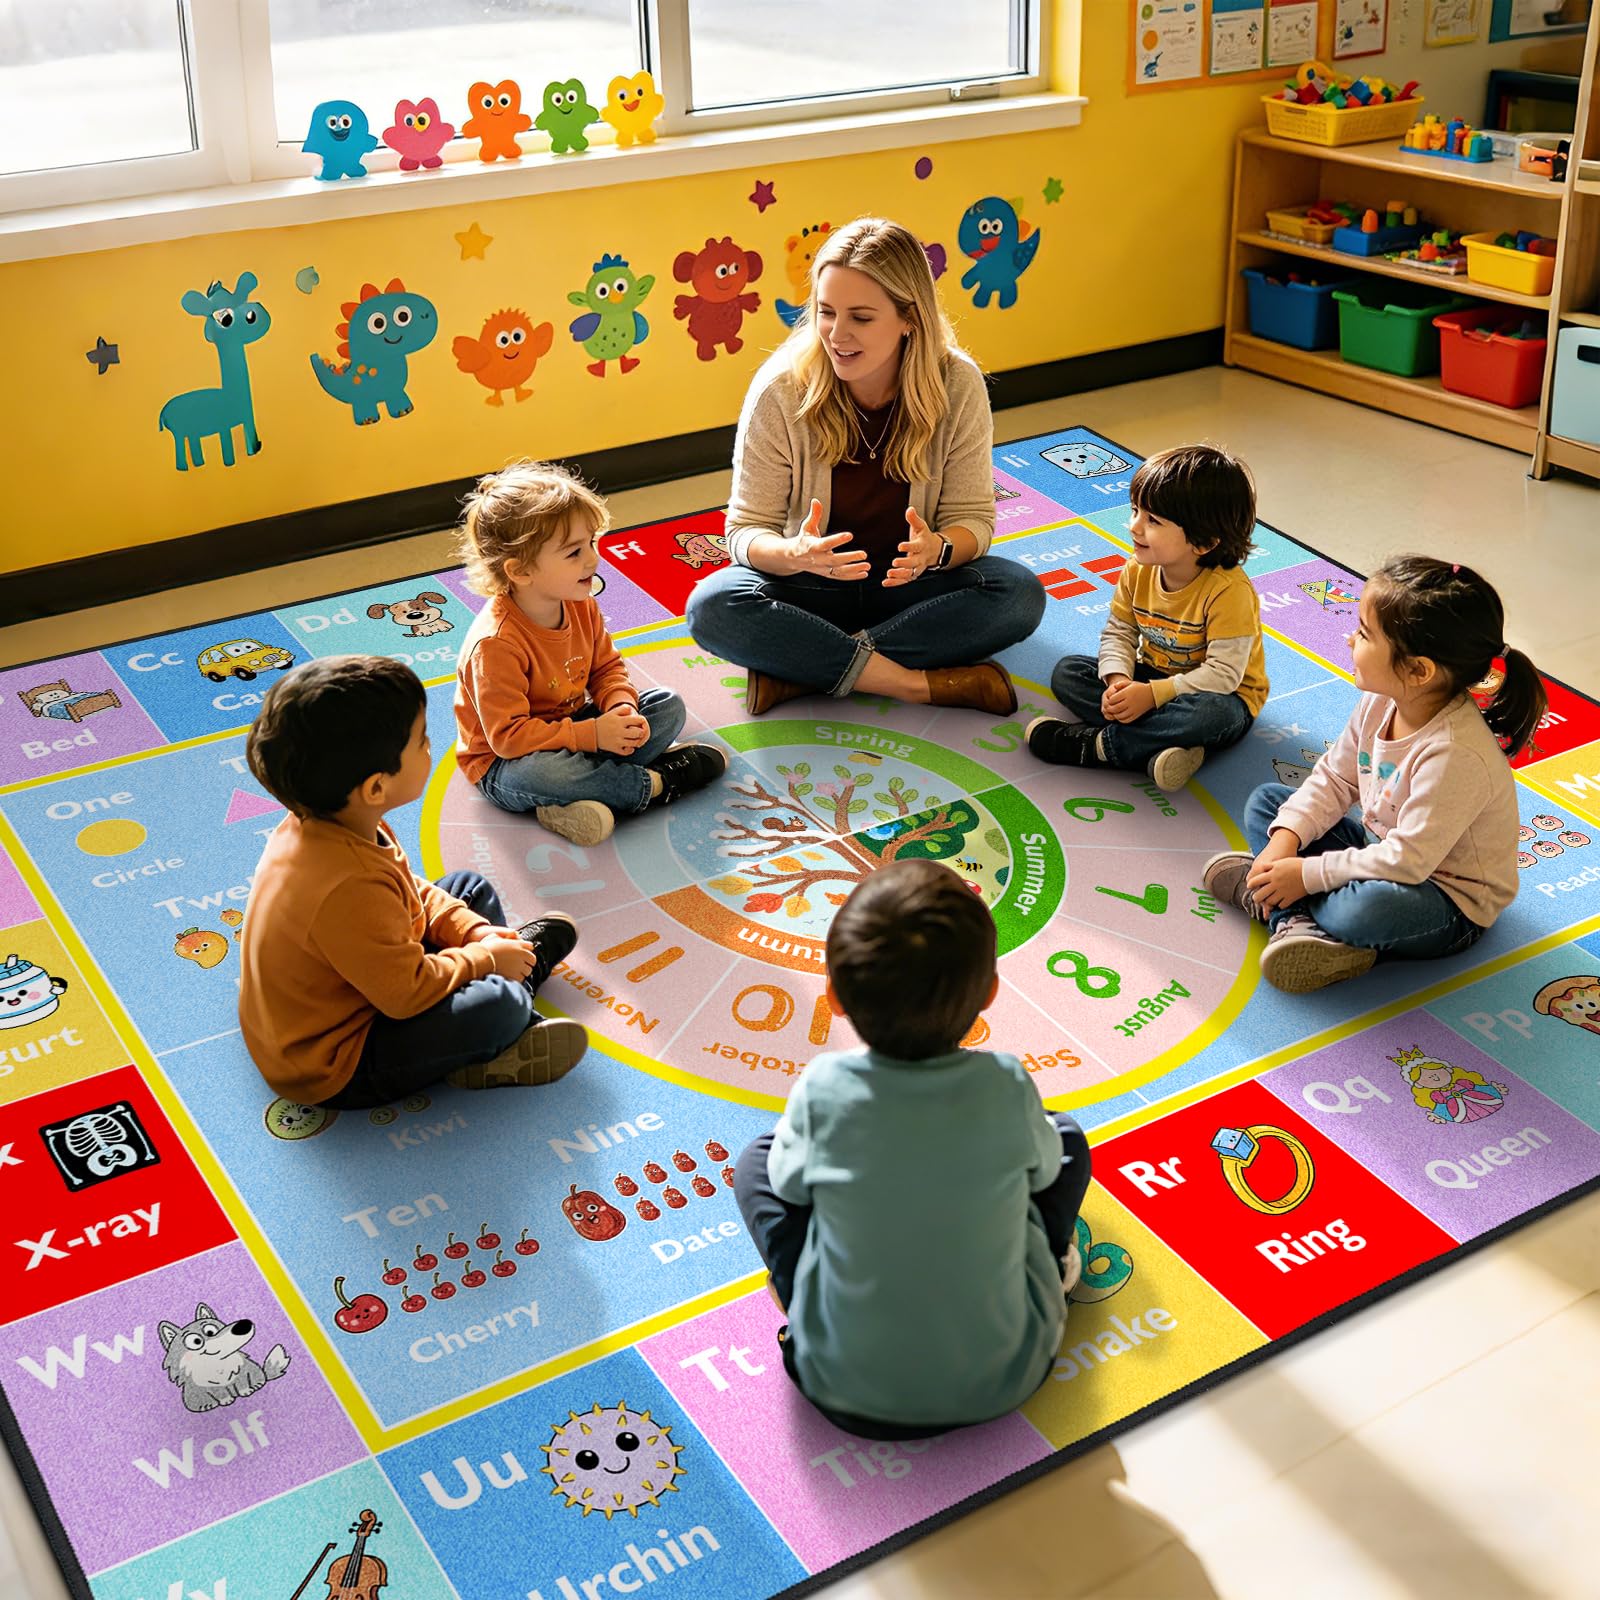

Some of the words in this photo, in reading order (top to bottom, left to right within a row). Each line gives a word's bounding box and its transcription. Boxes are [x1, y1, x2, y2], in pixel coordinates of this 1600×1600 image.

[1091, 478, 1130, 495] Ice
[996, 504, 1035, 521] use
[606, 540, 647, 561] Ff
[1017, 544, 1084, 567] Four
[296, 608, 359, 634] Dd
[128, 650, 184, 674] Cc
[20, 728, 98, 760] Bed
[814, 725, 918, 759] Spring
[45, 788, 135, 820] One
[1130, 780, 1178, 817] June
[1555, 772, 1600, 799] M
[1063, 797, 1136, 823] 6
[91, 855, 185, 889] Circle
[525, 843, 606, 898] 12
[1019, 832, 1047, 916] Summer
[152, 876, 254, 918] Twe
[1094, 883, 1169, 914] 7
[1190, 887, 1223, 923] July
[597, 931, 685, 983] 11
[737, 927, 826, 964] tumn
[1046, 949, 1122, 999] 8
[550, 961, 660, 1035] Novemb
[732, 984, 832, 1045] 10
[1113, 979, 1192, 1037] August
[1462, 1008, 1535, 1042] Pp
[0, 1026, 85, 1077] gurt
[702, 1041, 807, 1077] tober
[1022, 1048, 1082, 1073] Sep
[1301, 1074, 1394, 1115] Qq
[387, 1111, 468, 1150] Kiwi
[547, 1111, 666, 1164] Nine
[1118, 1154, 1187, 1198] Rr
[1425, 1126, 1552, 1191] Queen
[13, 1202, 161, 1271] X-ray
[342, 1191, 449, 1239] Ten
[649, 1219, 741, 1266] Date
[1255, 1217, 1368, 1274] Ring
[408, 1301, 540, 1364] Cherry
[1053, 1307, 1178, 1382] Snake
[15, 1325, 145, 1390] Ww
[677, 1343, 767, 1393] Tt
[131, 1410, 270, 1489] Wolf
[809, 1439, 945, 1488] Tig
[418, 1451, 529, 1511] Uu
